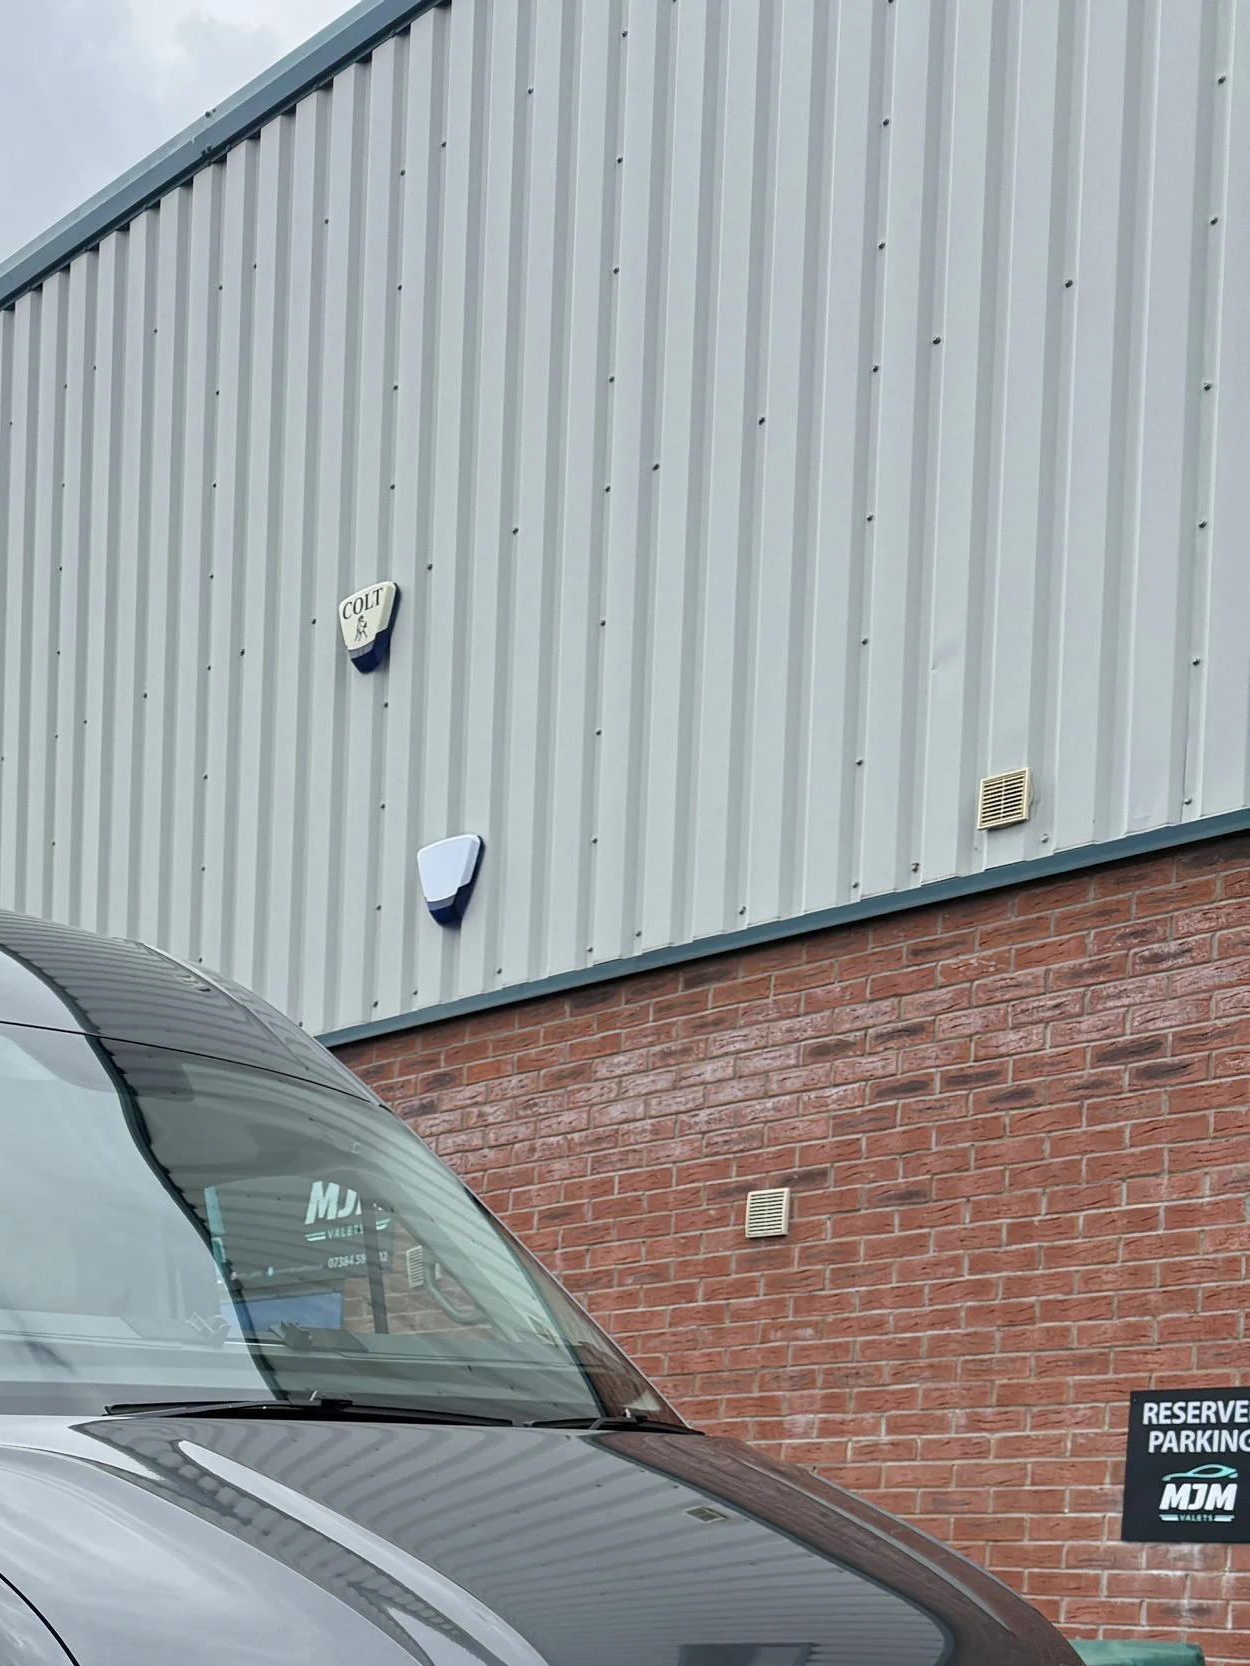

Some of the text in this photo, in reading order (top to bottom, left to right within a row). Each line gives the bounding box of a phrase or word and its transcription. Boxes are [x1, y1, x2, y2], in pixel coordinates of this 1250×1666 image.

[342, 587, 383, 620] COLT
[304, 1180, 382, 1225] MJ
[1142, 1400, 1250, 1425] RESERVE
[1148, 1429, 1250, 1453] PARKING
[1159, 1483, 1238, 1511] MJM
[1179, 1514, 1213, 1522] VALETS
